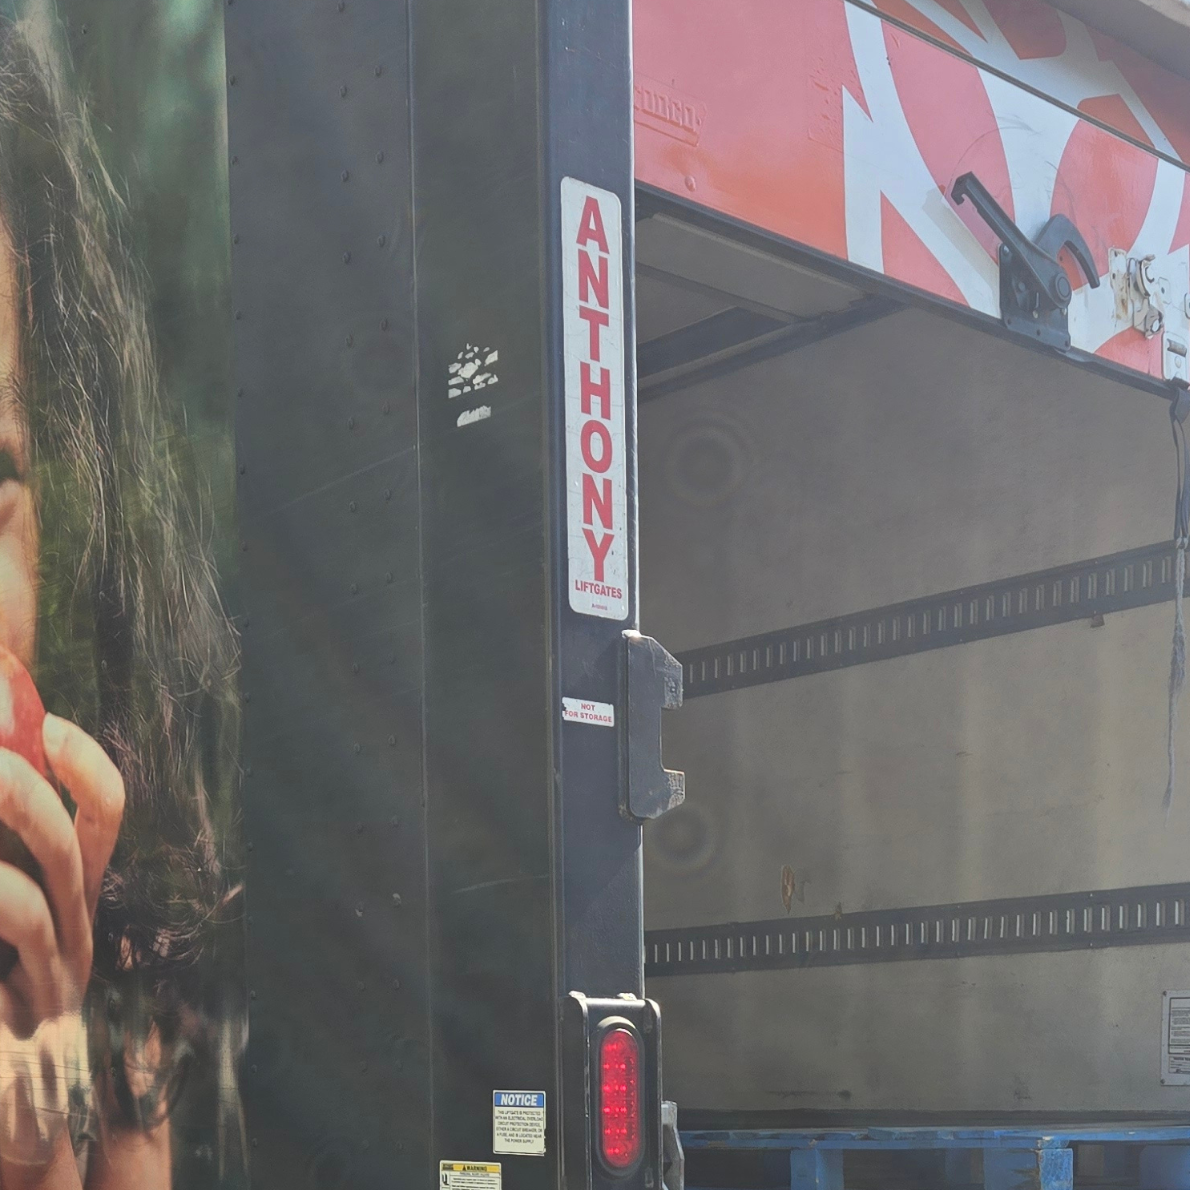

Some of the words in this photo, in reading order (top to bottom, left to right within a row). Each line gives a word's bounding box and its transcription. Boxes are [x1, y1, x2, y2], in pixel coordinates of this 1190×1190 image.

[576, 196, 615, 582] ANTHONY
[575, 579, 623, 599] LIFTGATES
[581, 702, 596, 711] NOT
[564, 710, 578, 718] FOR
[580, 711, 612, 723] STORAGE
[500, 1094, 538, 1106] NOTICE
